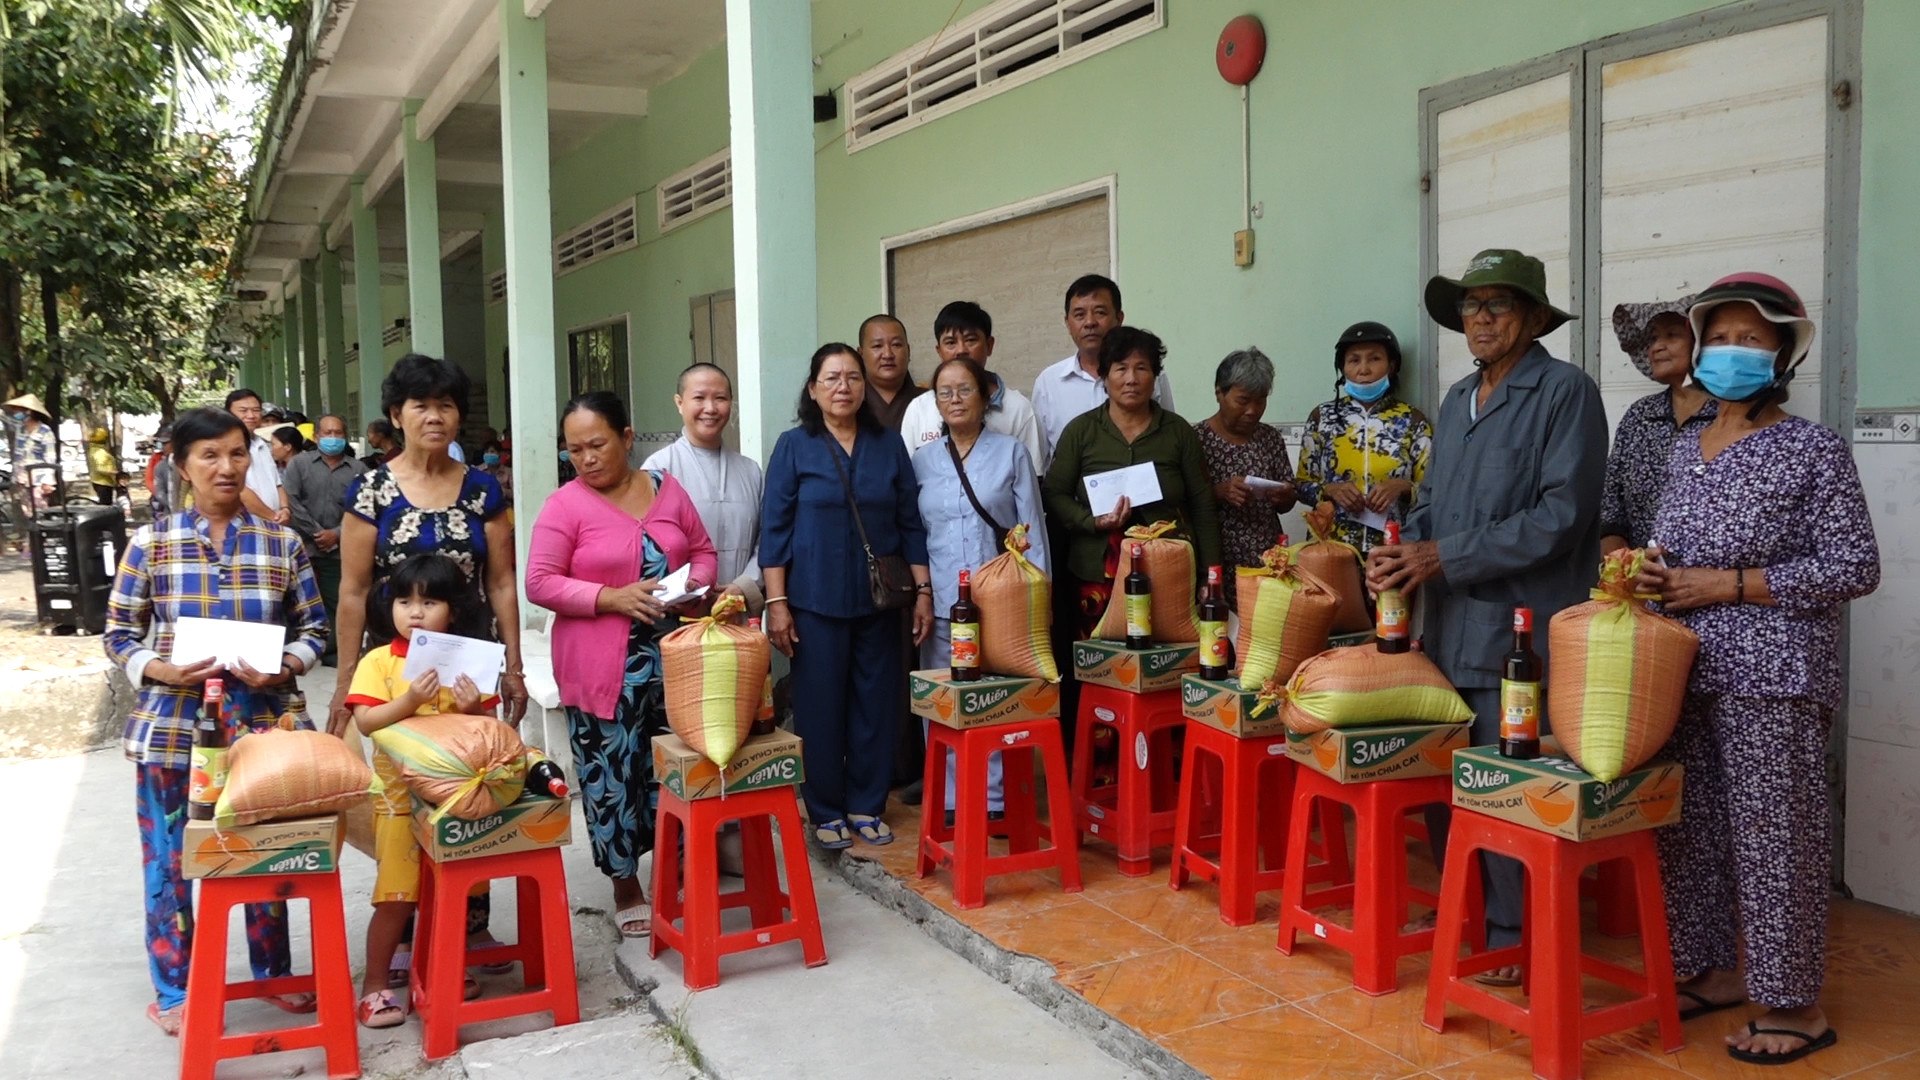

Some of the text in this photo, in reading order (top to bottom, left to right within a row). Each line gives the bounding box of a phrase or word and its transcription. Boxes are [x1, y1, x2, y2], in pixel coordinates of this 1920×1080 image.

[921, 431, 940, 441] USA
[1005, 702, 1020, 715] CAY
[732, 759, 750, 772] CAY
[1377, 763, 1401, 776] CHUA
[1402, 753, 1421, 767] CAY
[1481, 800, 1505, 809] CHUA
[1506, 797, 1524, 808] CAY
[471, 840, 499, 853] CHUA
[499, 829, 519, 844] CAY
